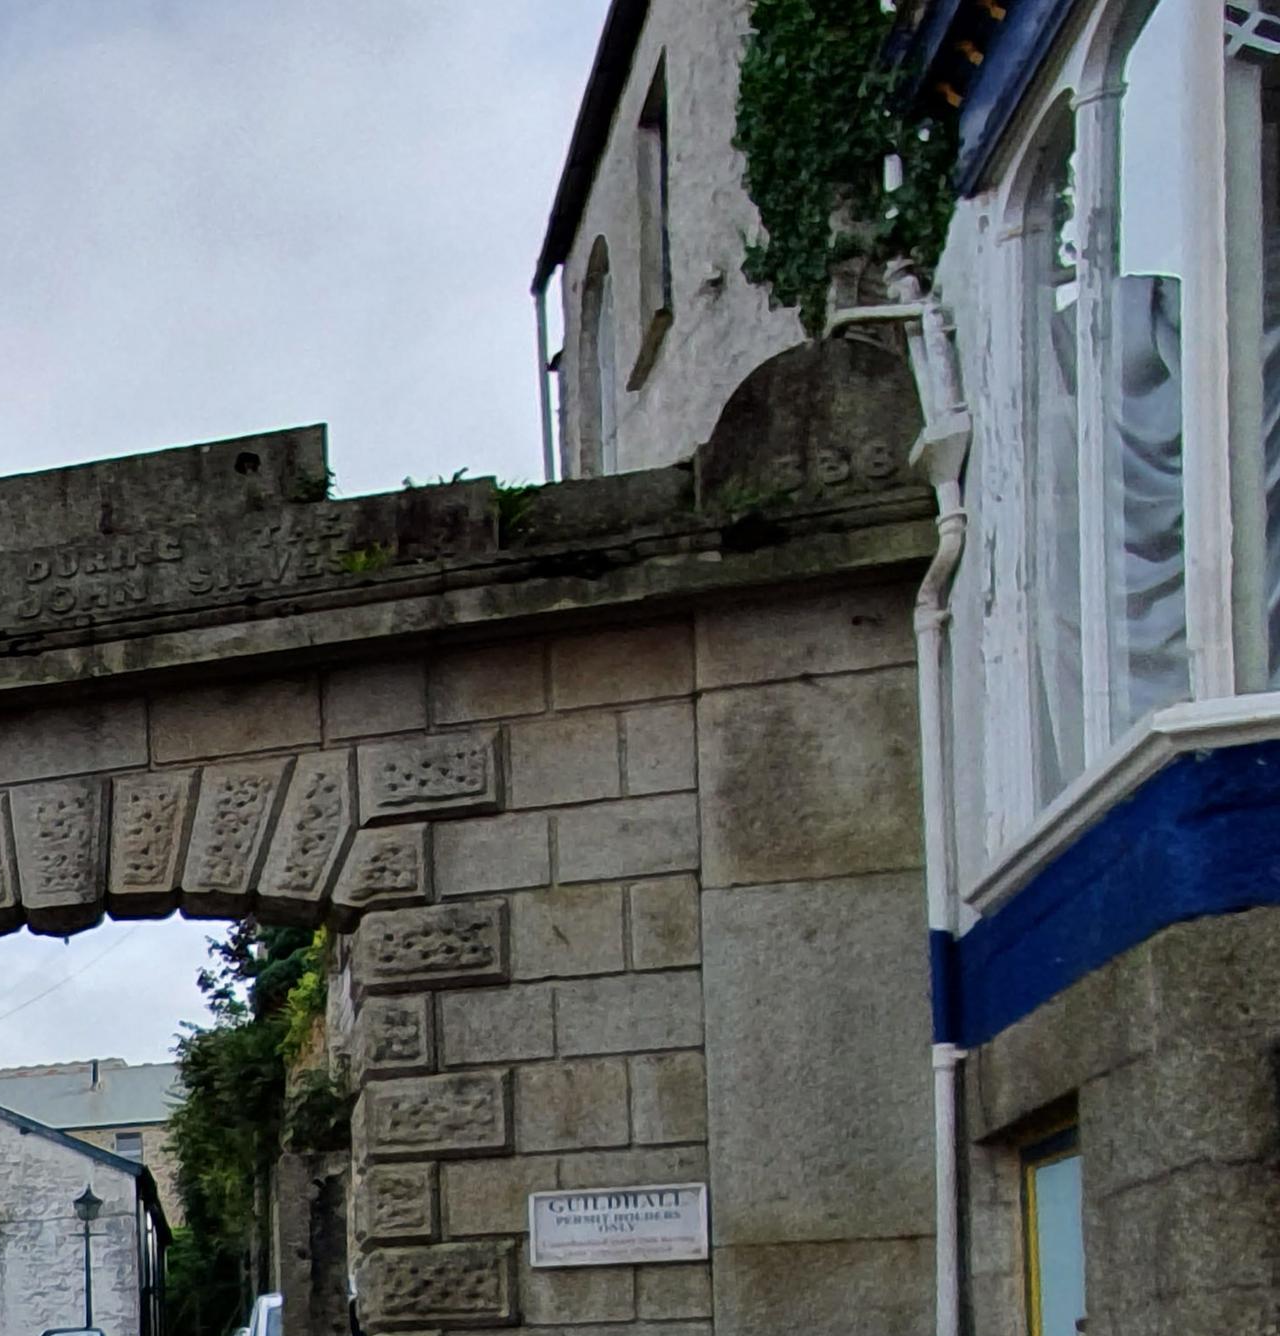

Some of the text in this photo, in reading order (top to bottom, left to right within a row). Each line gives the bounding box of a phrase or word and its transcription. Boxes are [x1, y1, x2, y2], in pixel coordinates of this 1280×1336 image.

[548, 1191, 687, 1213] GUILDHALL
[556, 1210, 681, 1226] PERMIT HOLDERS
